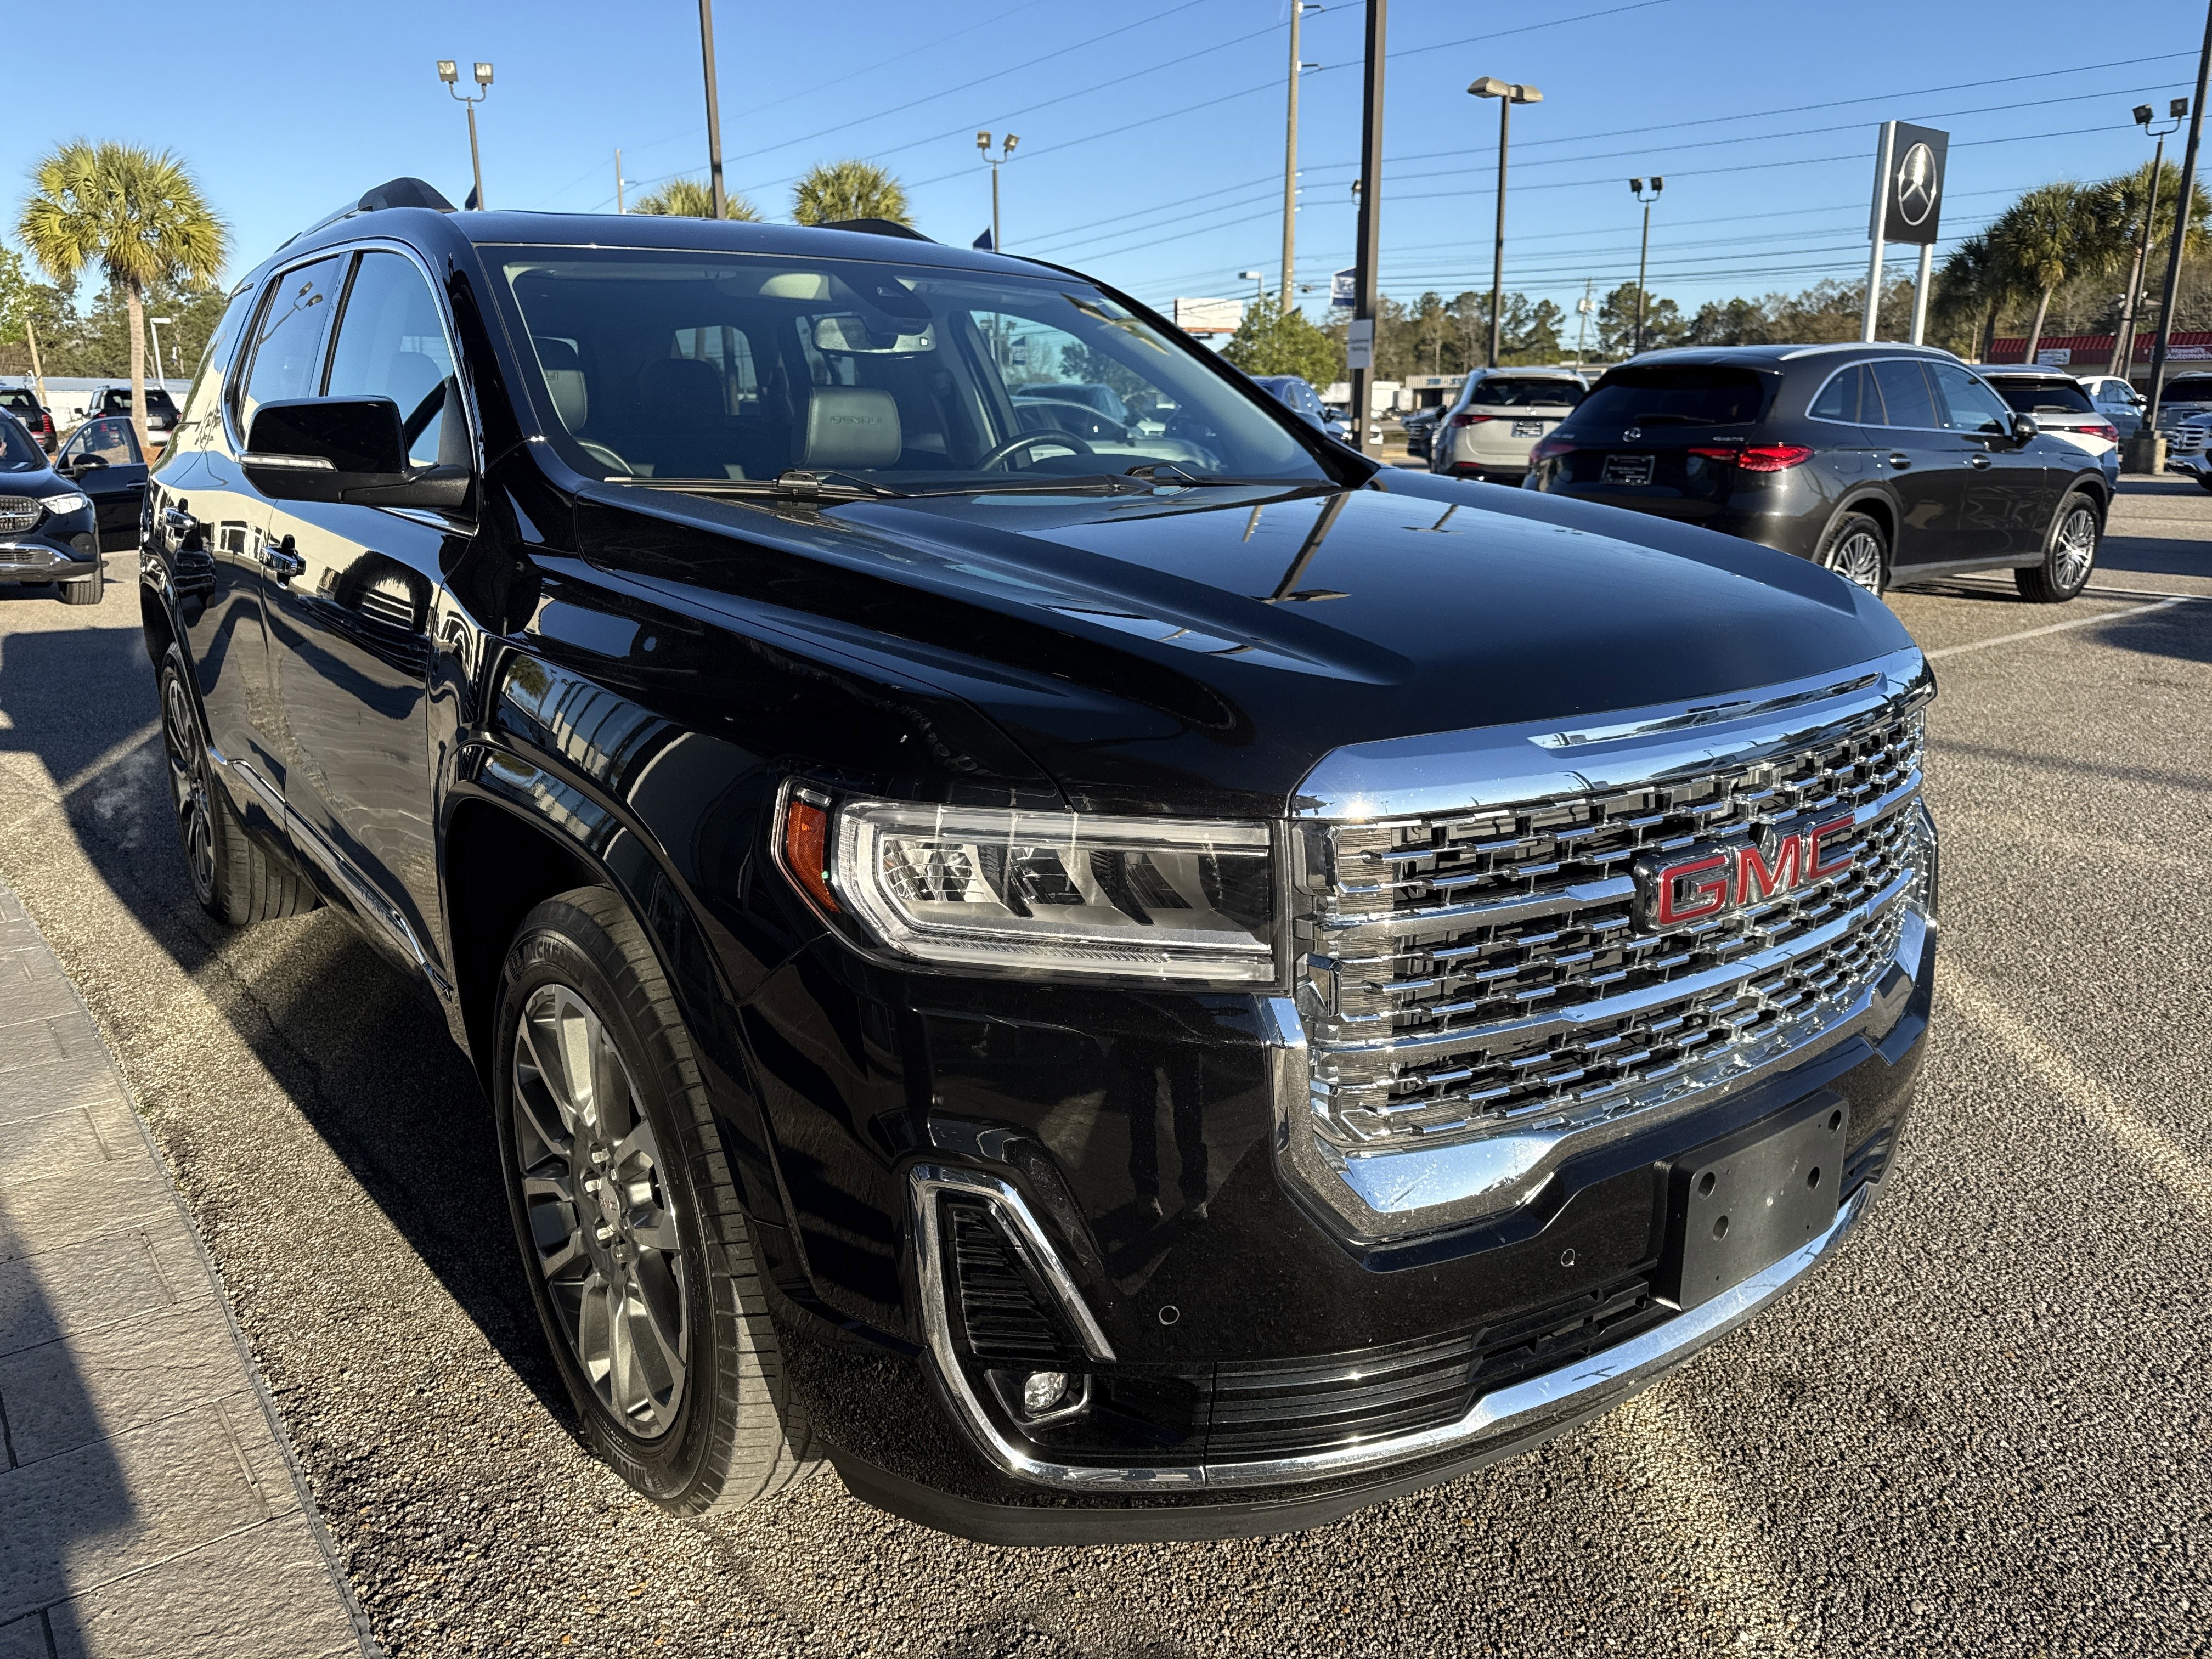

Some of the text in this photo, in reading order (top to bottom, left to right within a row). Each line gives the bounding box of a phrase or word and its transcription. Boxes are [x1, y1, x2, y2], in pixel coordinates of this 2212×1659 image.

[830, 416, 882, 425] DENALI
[1658, 815, 1855, 926] GMC
[523, 940, 585, 988] MICHELIN
